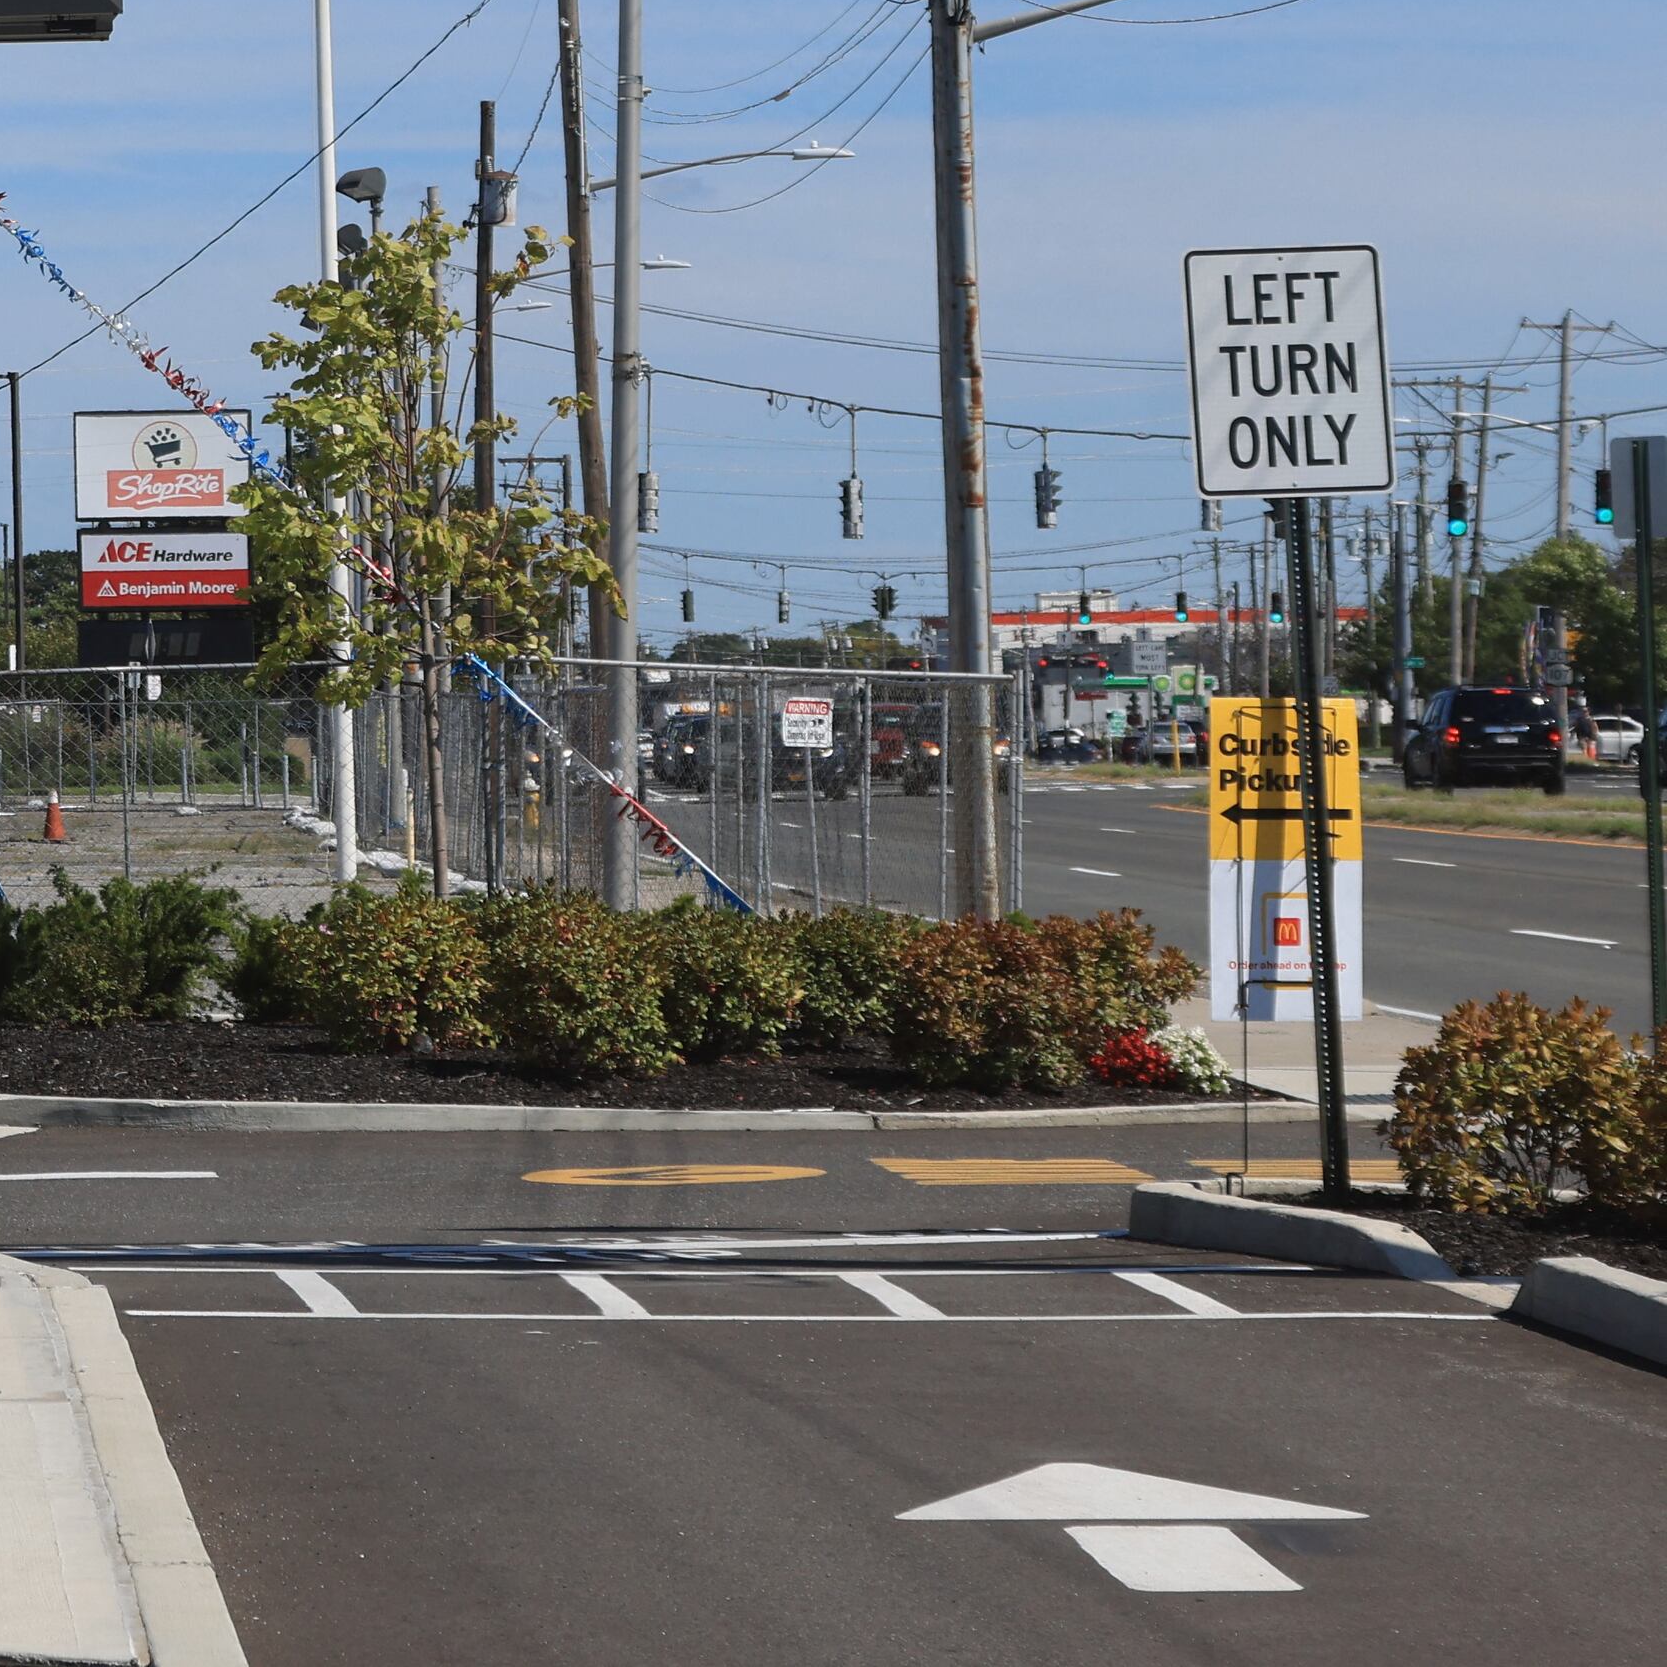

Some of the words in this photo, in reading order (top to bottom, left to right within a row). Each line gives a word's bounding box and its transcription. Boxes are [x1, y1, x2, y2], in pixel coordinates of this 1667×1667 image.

[1224, 272, 1340, 325] LEFT
[1219, 342, 1359, 397] TURN
[1229, 413, 1357, 470] ONLY
[115, 473, 220, 506] ShopRite
[98, 539, 153, 563] ACE
[153, 549, 233, 563] Hardware
[119, 581, 185, 599] Benjamin
[189, 582, 235, 594] Moore
[788, 702, 828, 714] WARNING
[1219, 732, 1351, 757] Curbsde
[1219, 768, 1302, 792] Picku
[1228, 961, 1258, 971] Order
[1260, 961, 1292, 971] ahead
[1294, 962, 1307, 971] on
[381, 1249, 742, 1263] STOP
